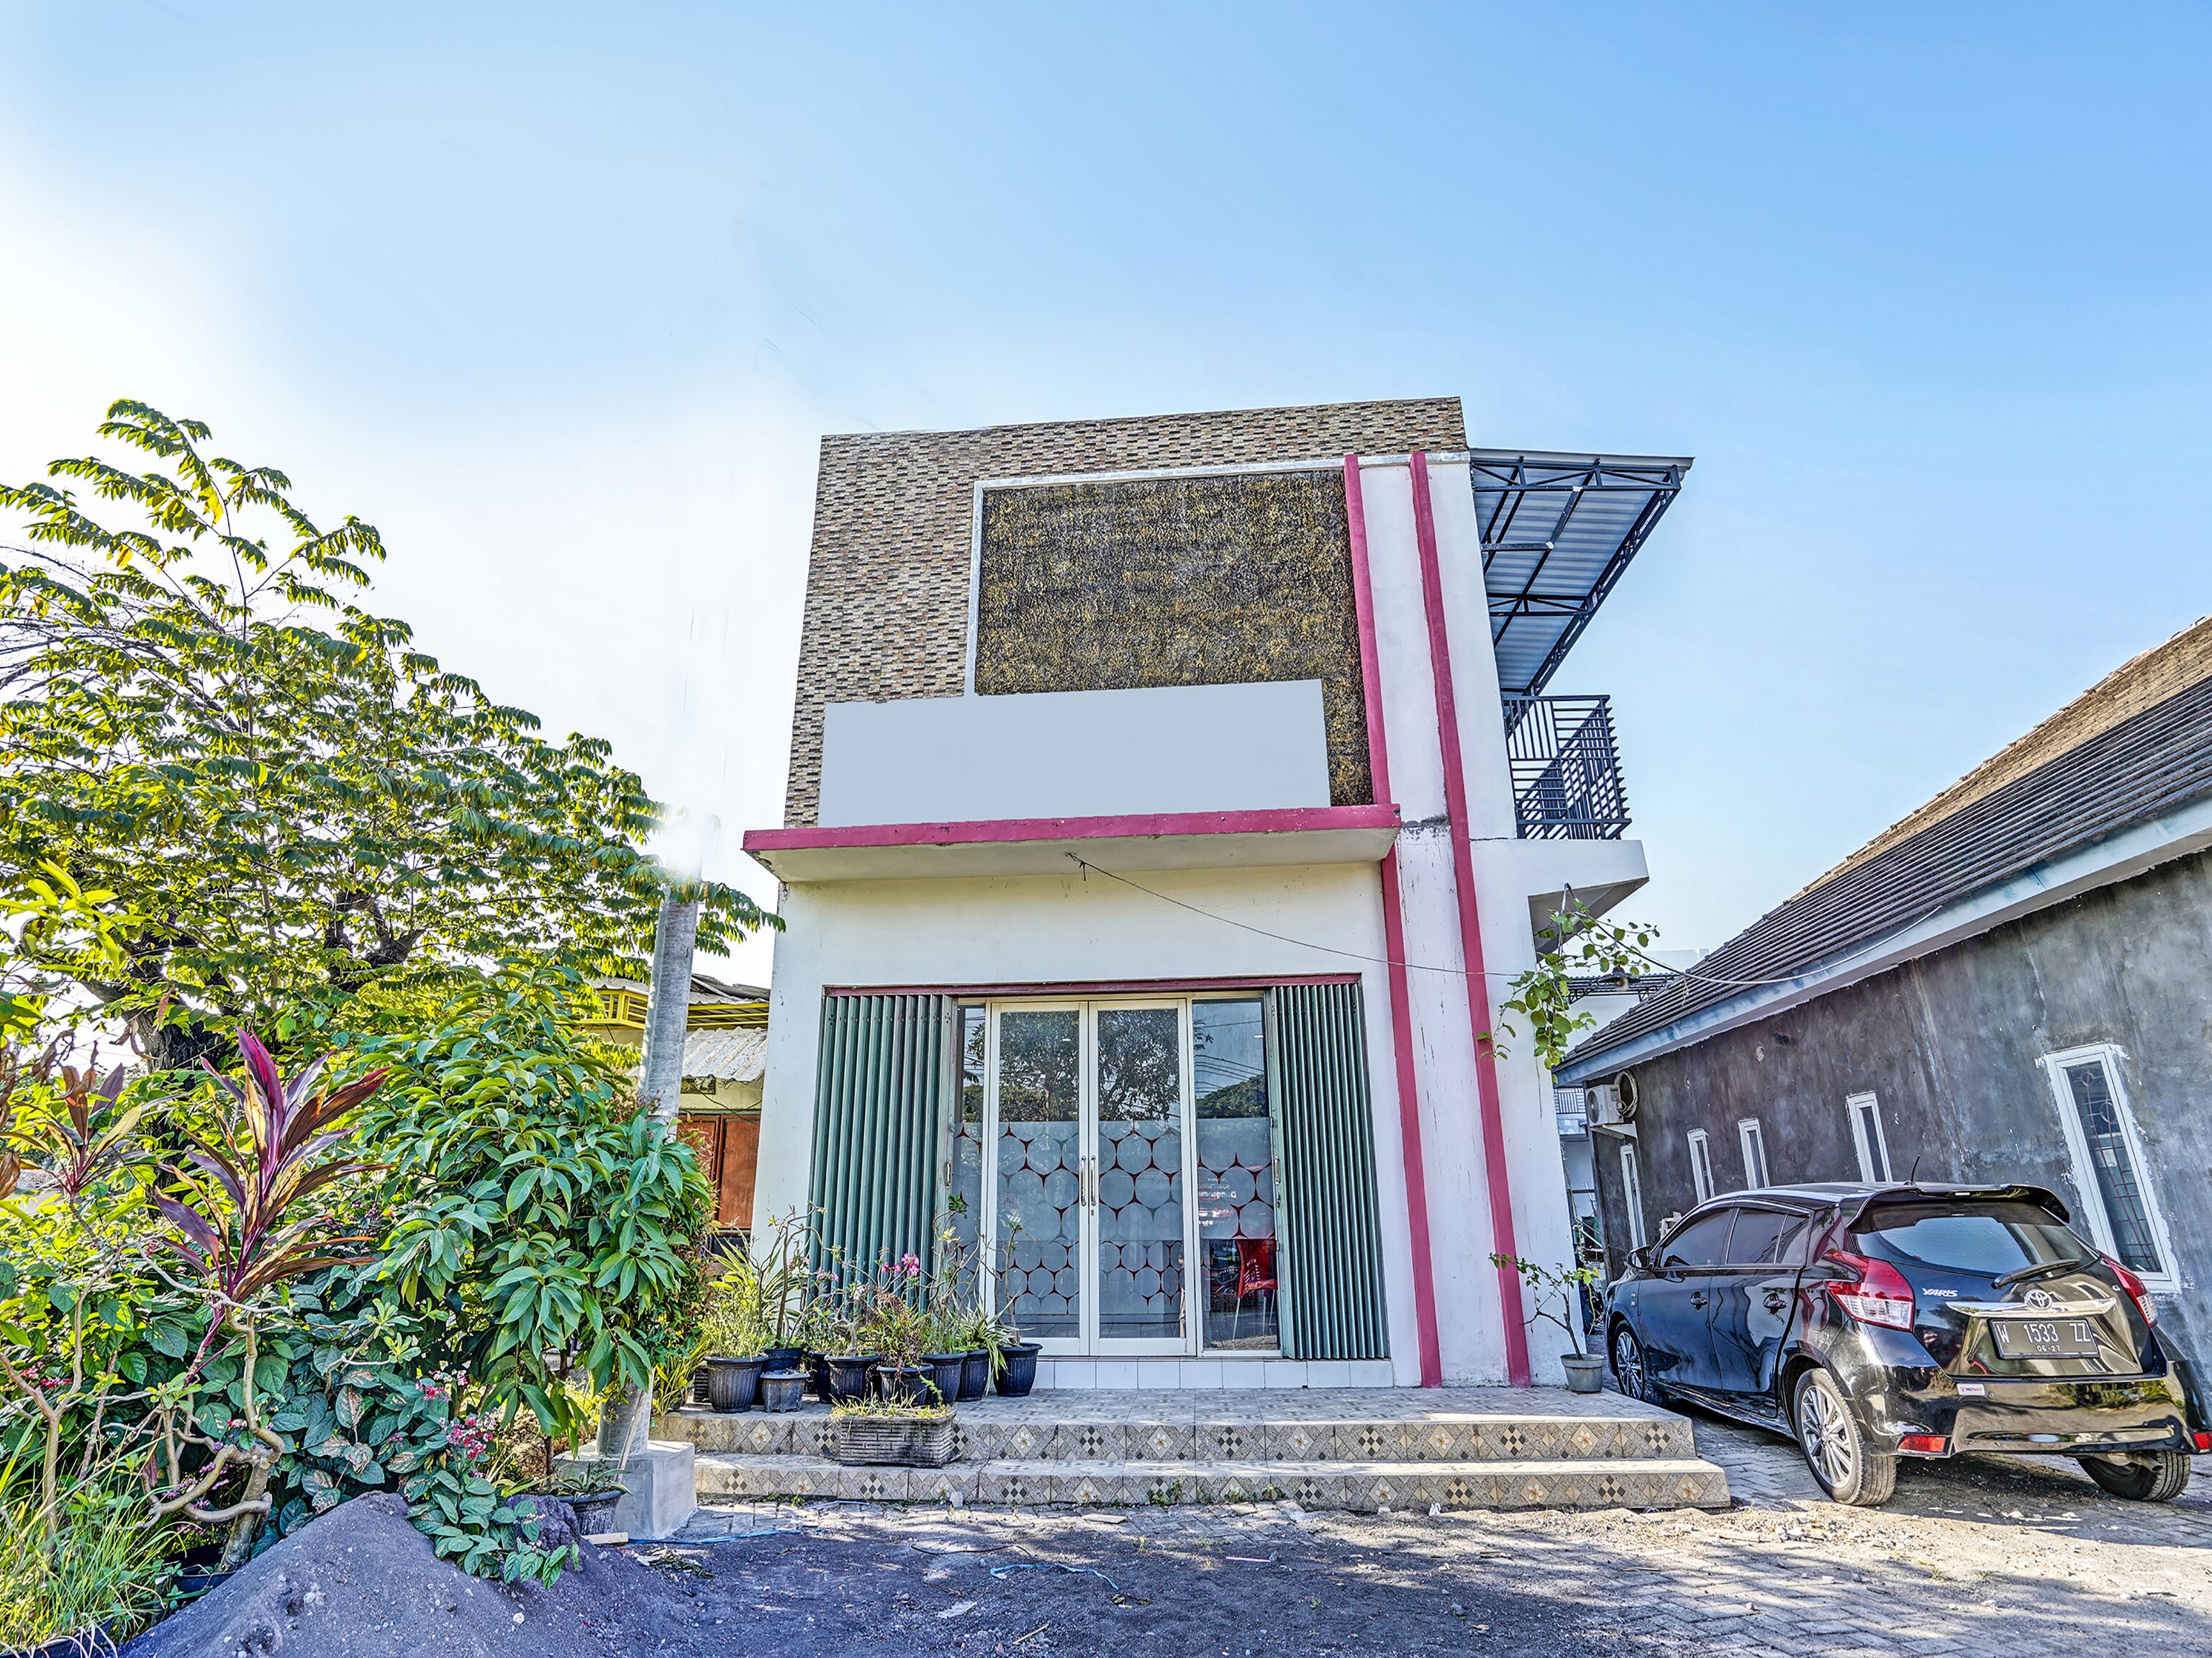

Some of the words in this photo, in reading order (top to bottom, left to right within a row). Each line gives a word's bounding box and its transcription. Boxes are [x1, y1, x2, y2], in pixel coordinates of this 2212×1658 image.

[1921, 1287, 1958, 1297] YARIS
[1996, 1324, 2010, 1344] W
[2023, 1323, 2059, 1344] 1533
[2069, 1323, 2091, 1342] ZZ
